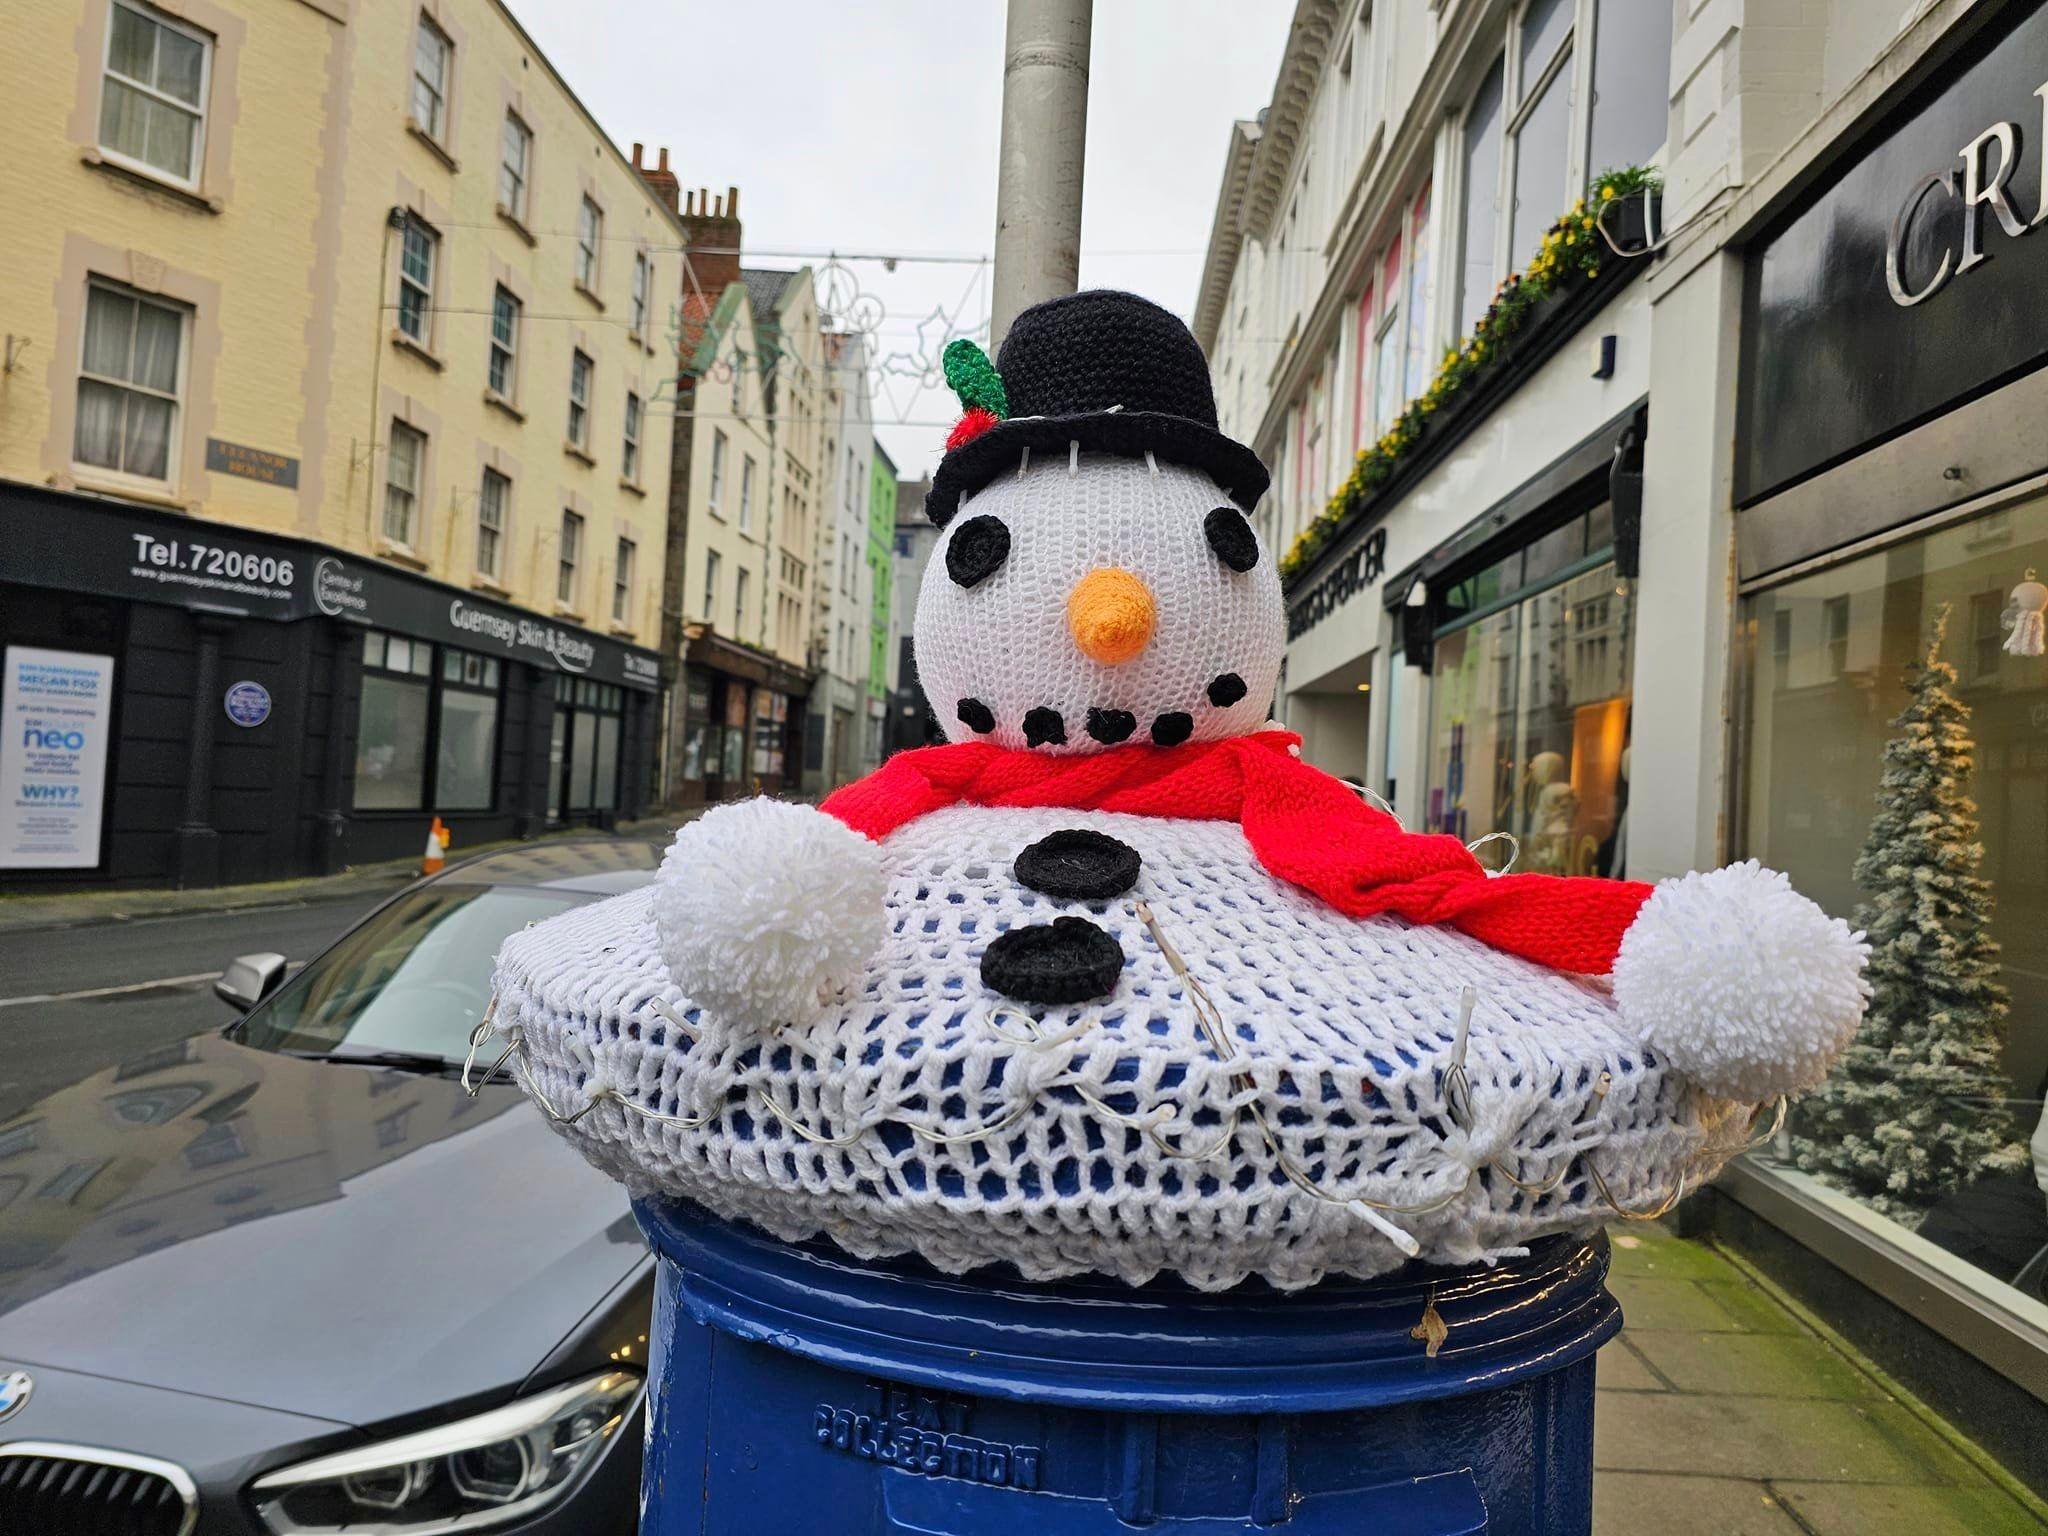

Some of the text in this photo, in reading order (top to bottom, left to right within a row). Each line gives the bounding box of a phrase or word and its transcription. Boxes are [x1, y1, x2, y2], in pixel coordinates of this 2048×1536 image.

[450, 600, 517, 648] Guernsey
[517, 620, 546, 650] Skin
[23, 729, 84, 750] neo
[22, 784, 79, 801] WHY?
[814, 1403, 1041, 1489] COLLECTION
